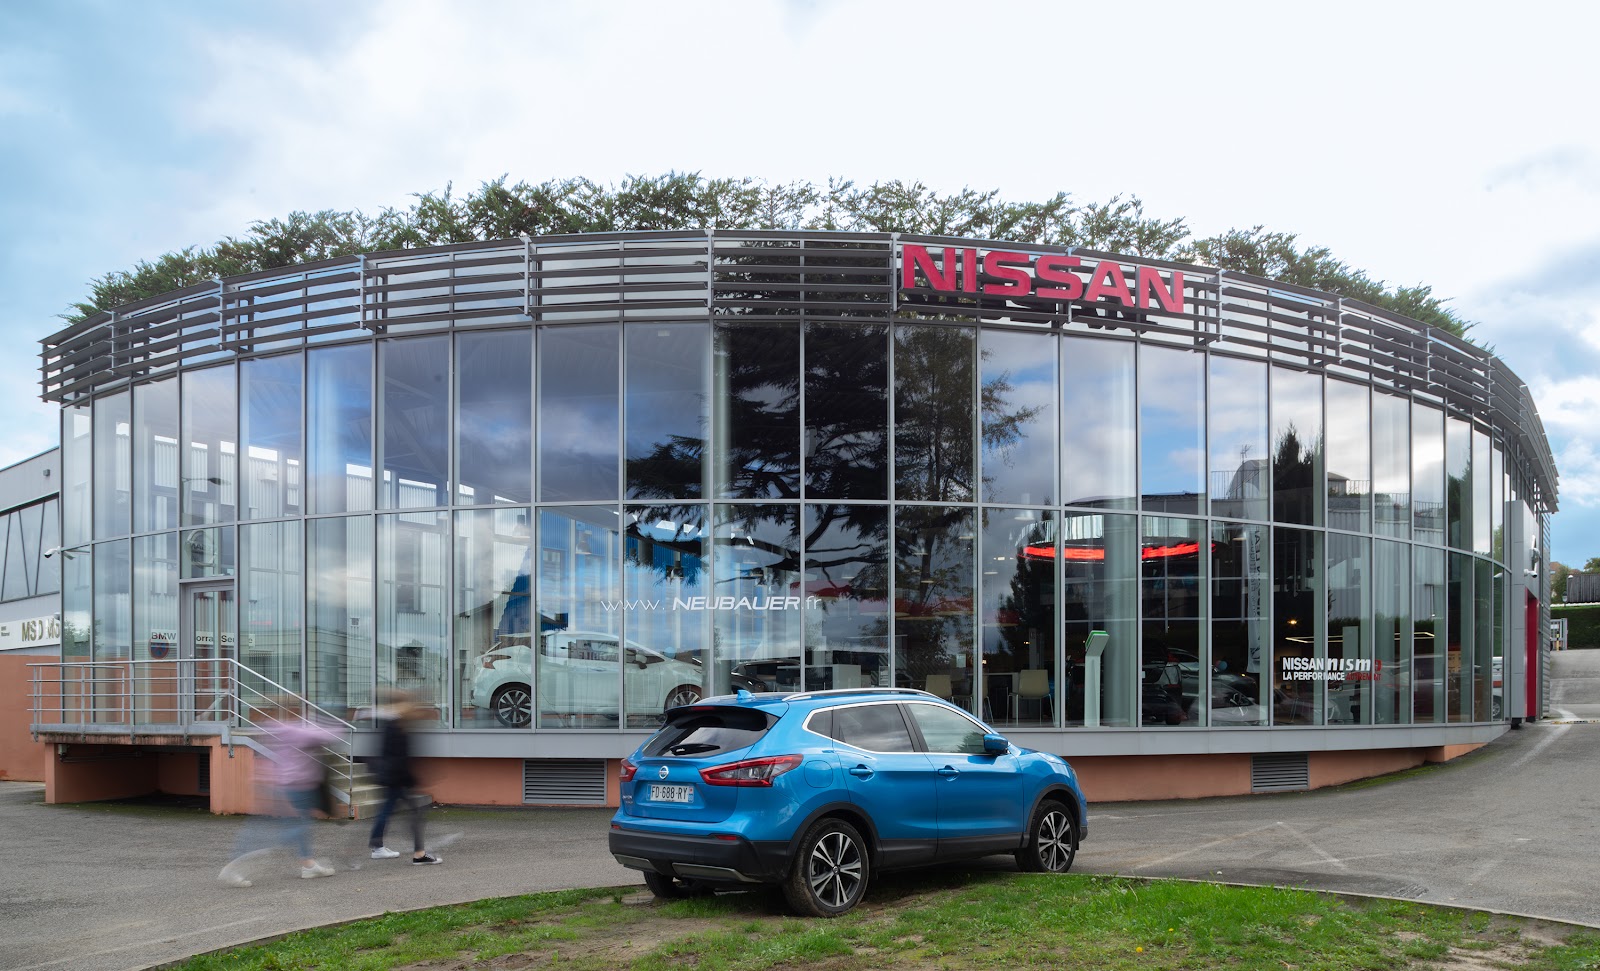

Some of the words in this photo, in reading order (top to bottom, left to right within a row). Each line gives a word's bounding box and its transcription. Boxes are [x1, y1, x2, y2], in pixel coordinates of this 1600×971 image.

[901, 244, 1185, 314] NISSAN
[600, 599, 665, 611] www.
[672, 595, 822, 611] NEUBAUER.fr
[151, 631, 177, 640] BMW
[1282, 657, 1325, 671] NISSAN
[1282, 672, 1293, 681] LA
[651, 786, 688, 800] FD-688-RY
